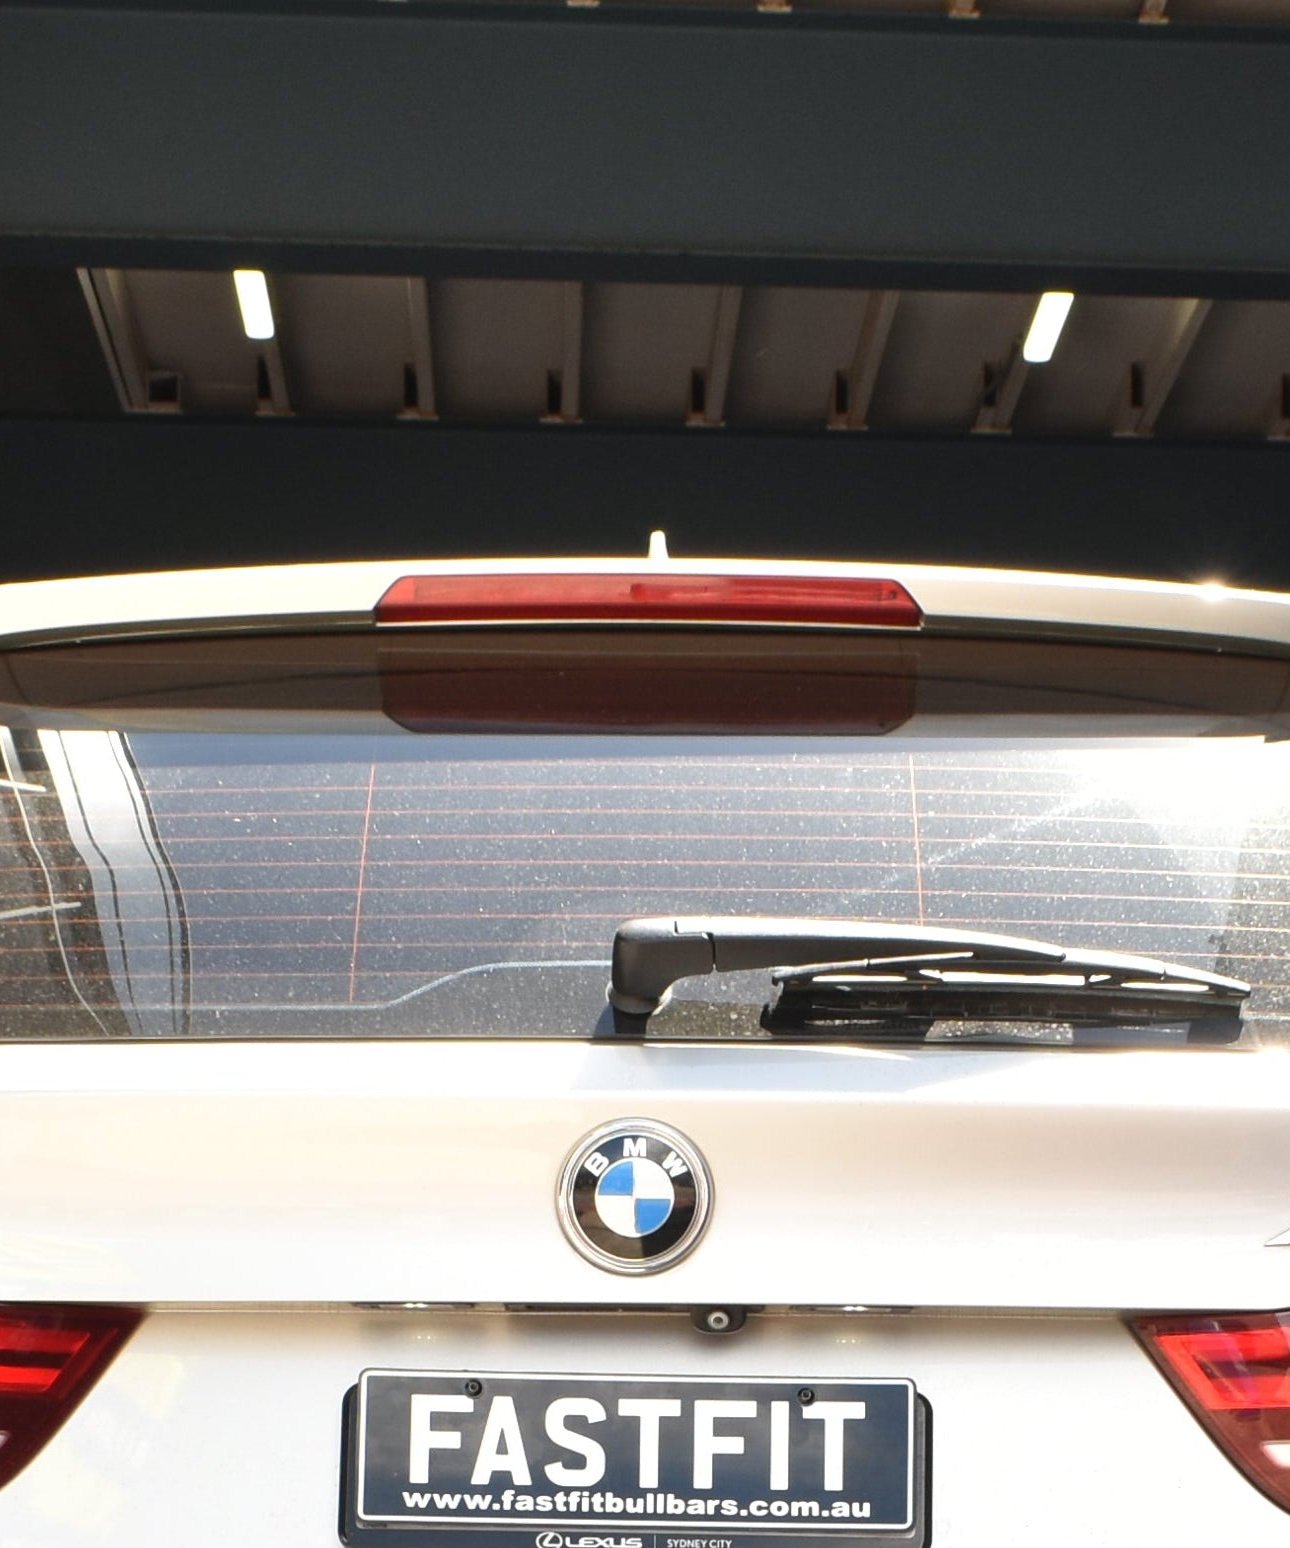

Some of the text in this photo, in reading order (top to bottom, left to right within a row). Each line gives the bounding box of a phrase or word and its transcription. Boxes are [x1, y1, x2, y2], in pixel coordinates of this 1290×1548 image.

[583, 1137, 689, 1178] BMW
[408, 1393, 867, 1492] FASTFIT
[402, 1488, 872, 1518] www.fastfitbullbars.com.au
[565, 1537, 643, 1548] LEXUS
